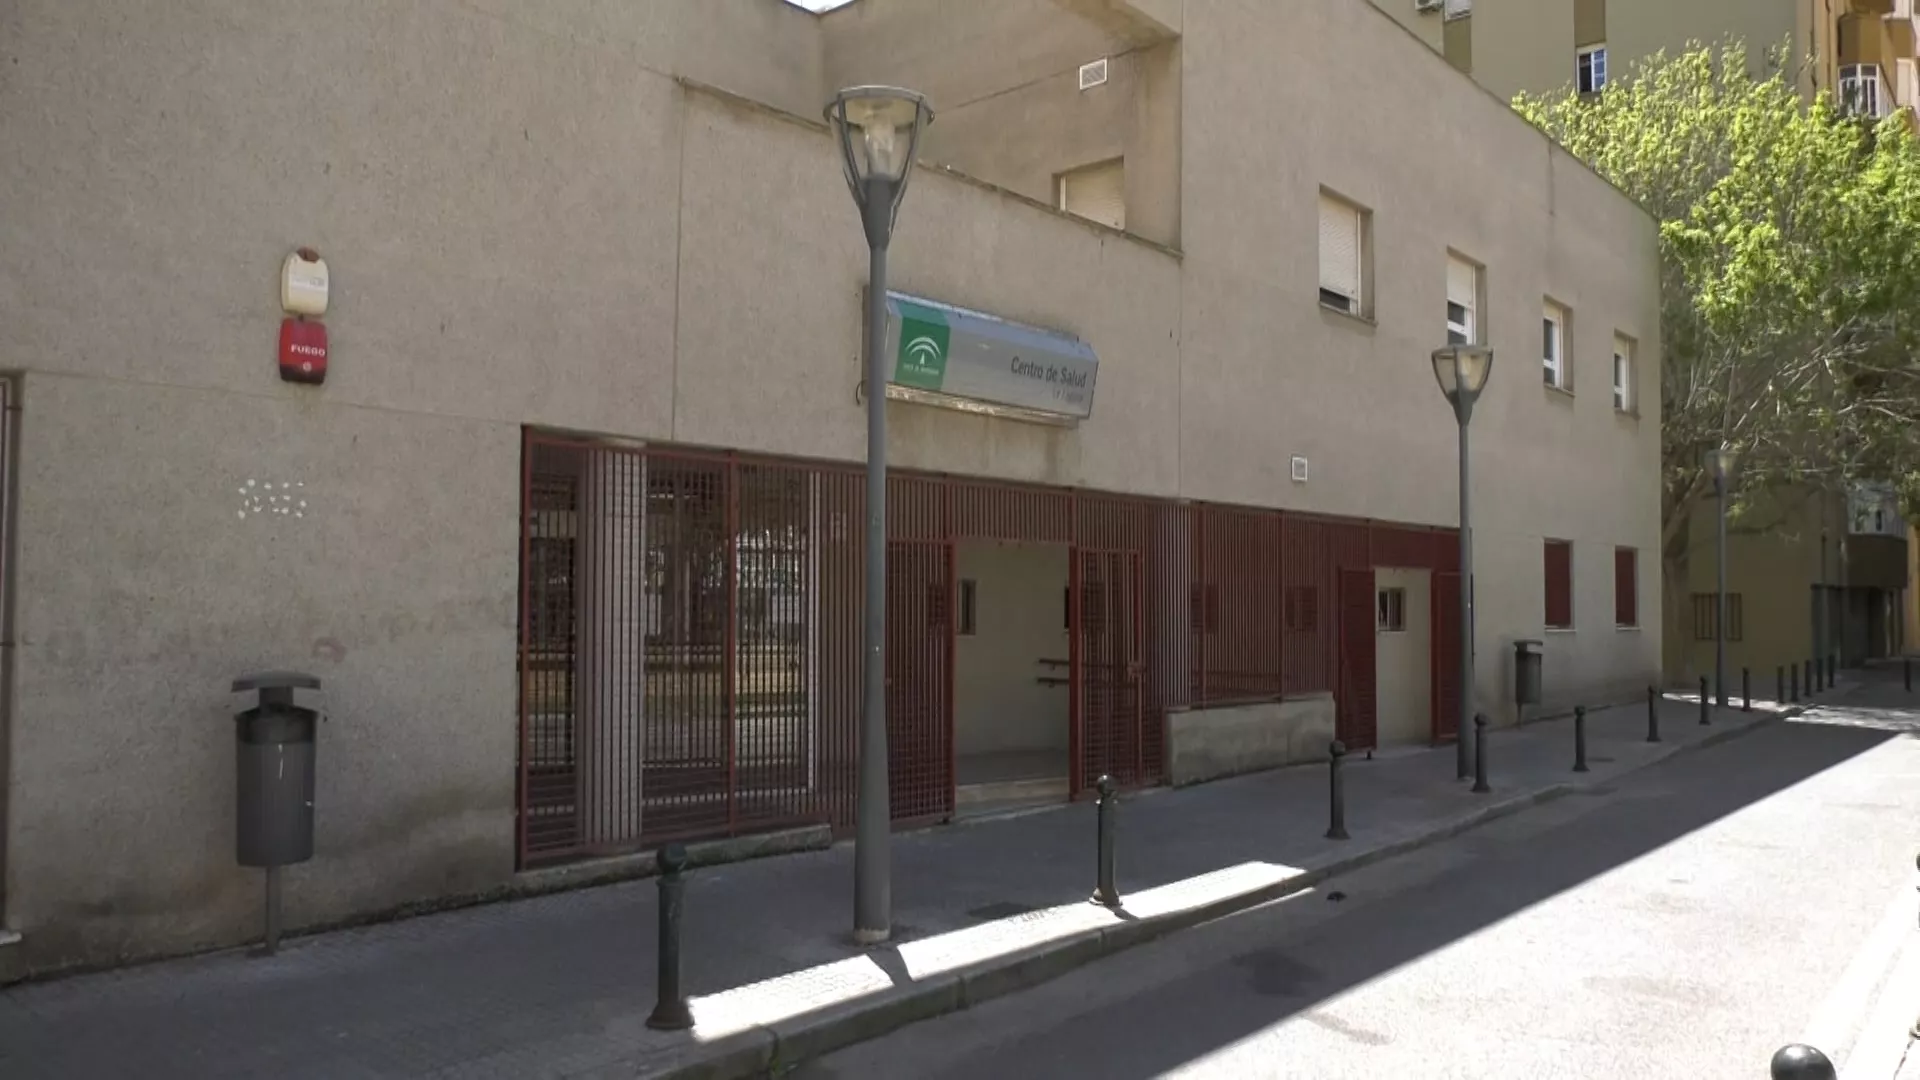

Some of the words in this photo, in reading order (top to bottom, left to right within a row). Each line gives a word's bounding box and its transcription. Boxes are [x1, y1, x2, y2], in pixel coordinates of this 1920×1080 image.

[290, 344, 326, 357] FUEGO
[1010, 356, 1043, 378] Centro
[1045, 364, 1058, 382] de
[1060, 366, 1087, 388] Salud
